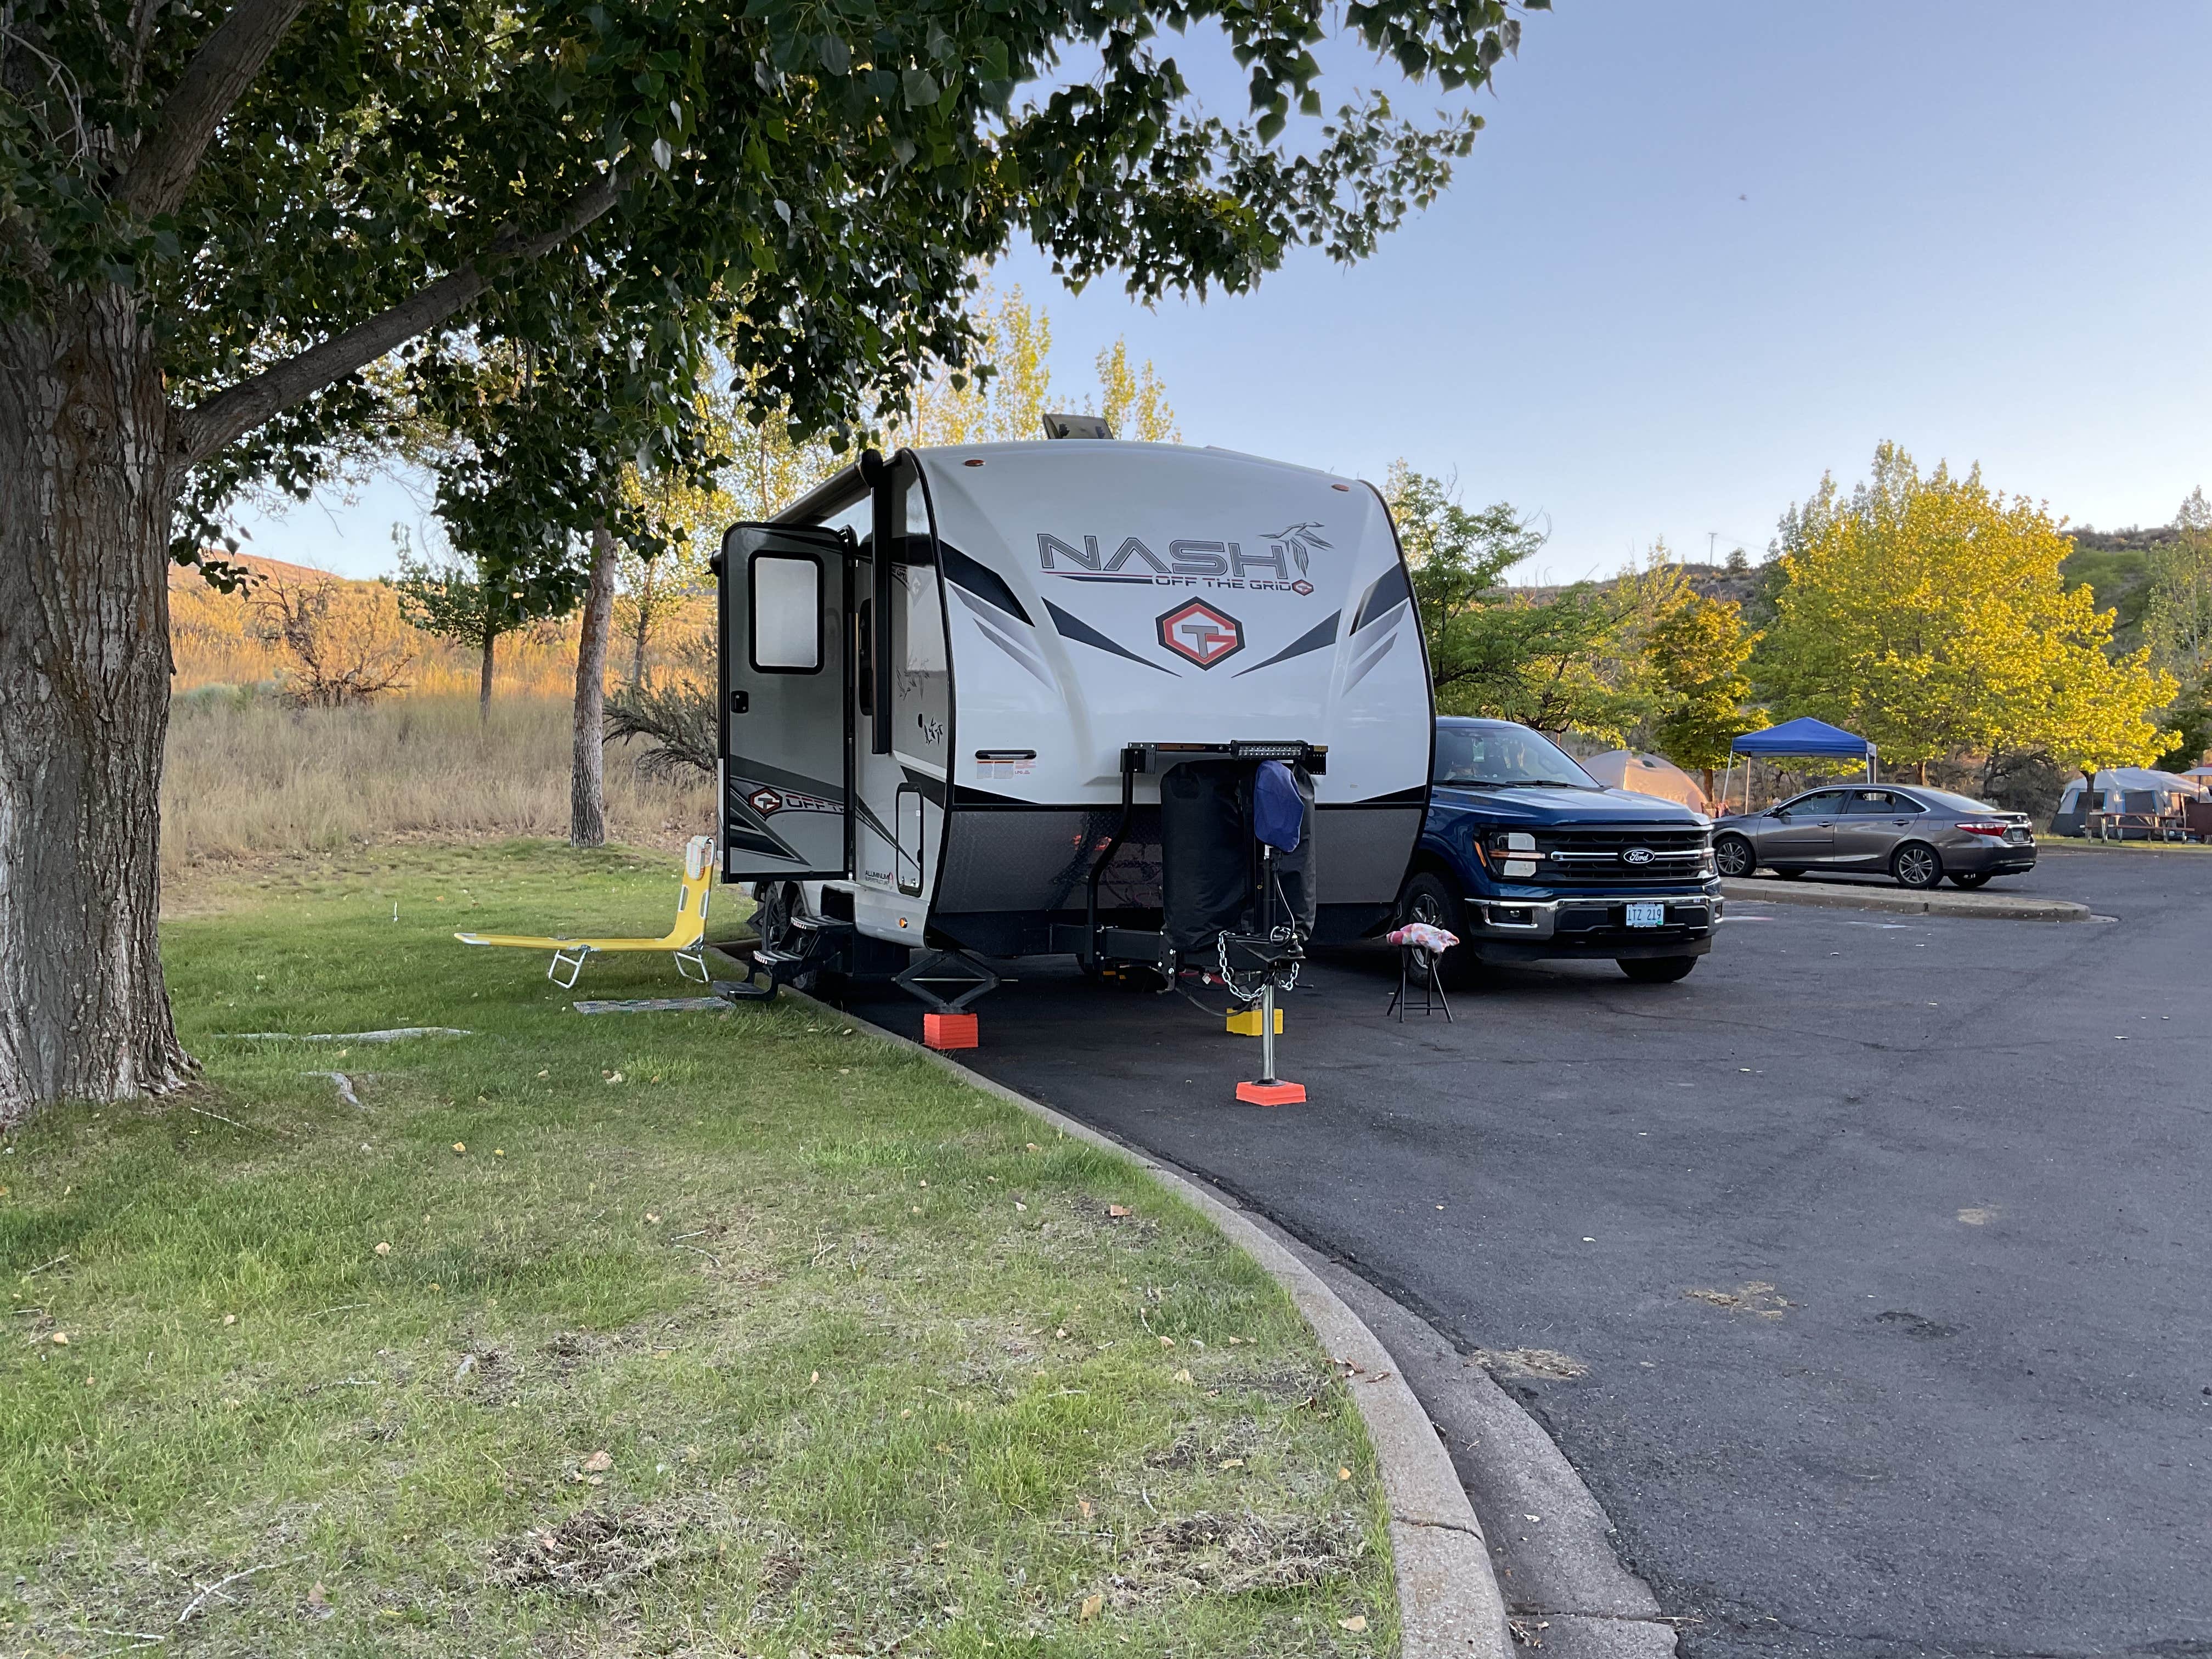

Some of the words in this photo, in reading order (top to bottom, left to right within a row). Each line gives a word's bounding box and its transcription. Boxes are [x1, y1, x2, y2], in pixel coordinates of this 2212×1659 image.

[1037, 533, 1288, 579] NASH
[1155, 575, 1197, 586] OFF
[1202, 577, 1245, 589] THE
[1249, 580, 1291, 591] GRID
[785, 794, 826, 809] OFF
[1629, 851, 1649, 861] Ford
[1647, 909, 1662, 921] 219
